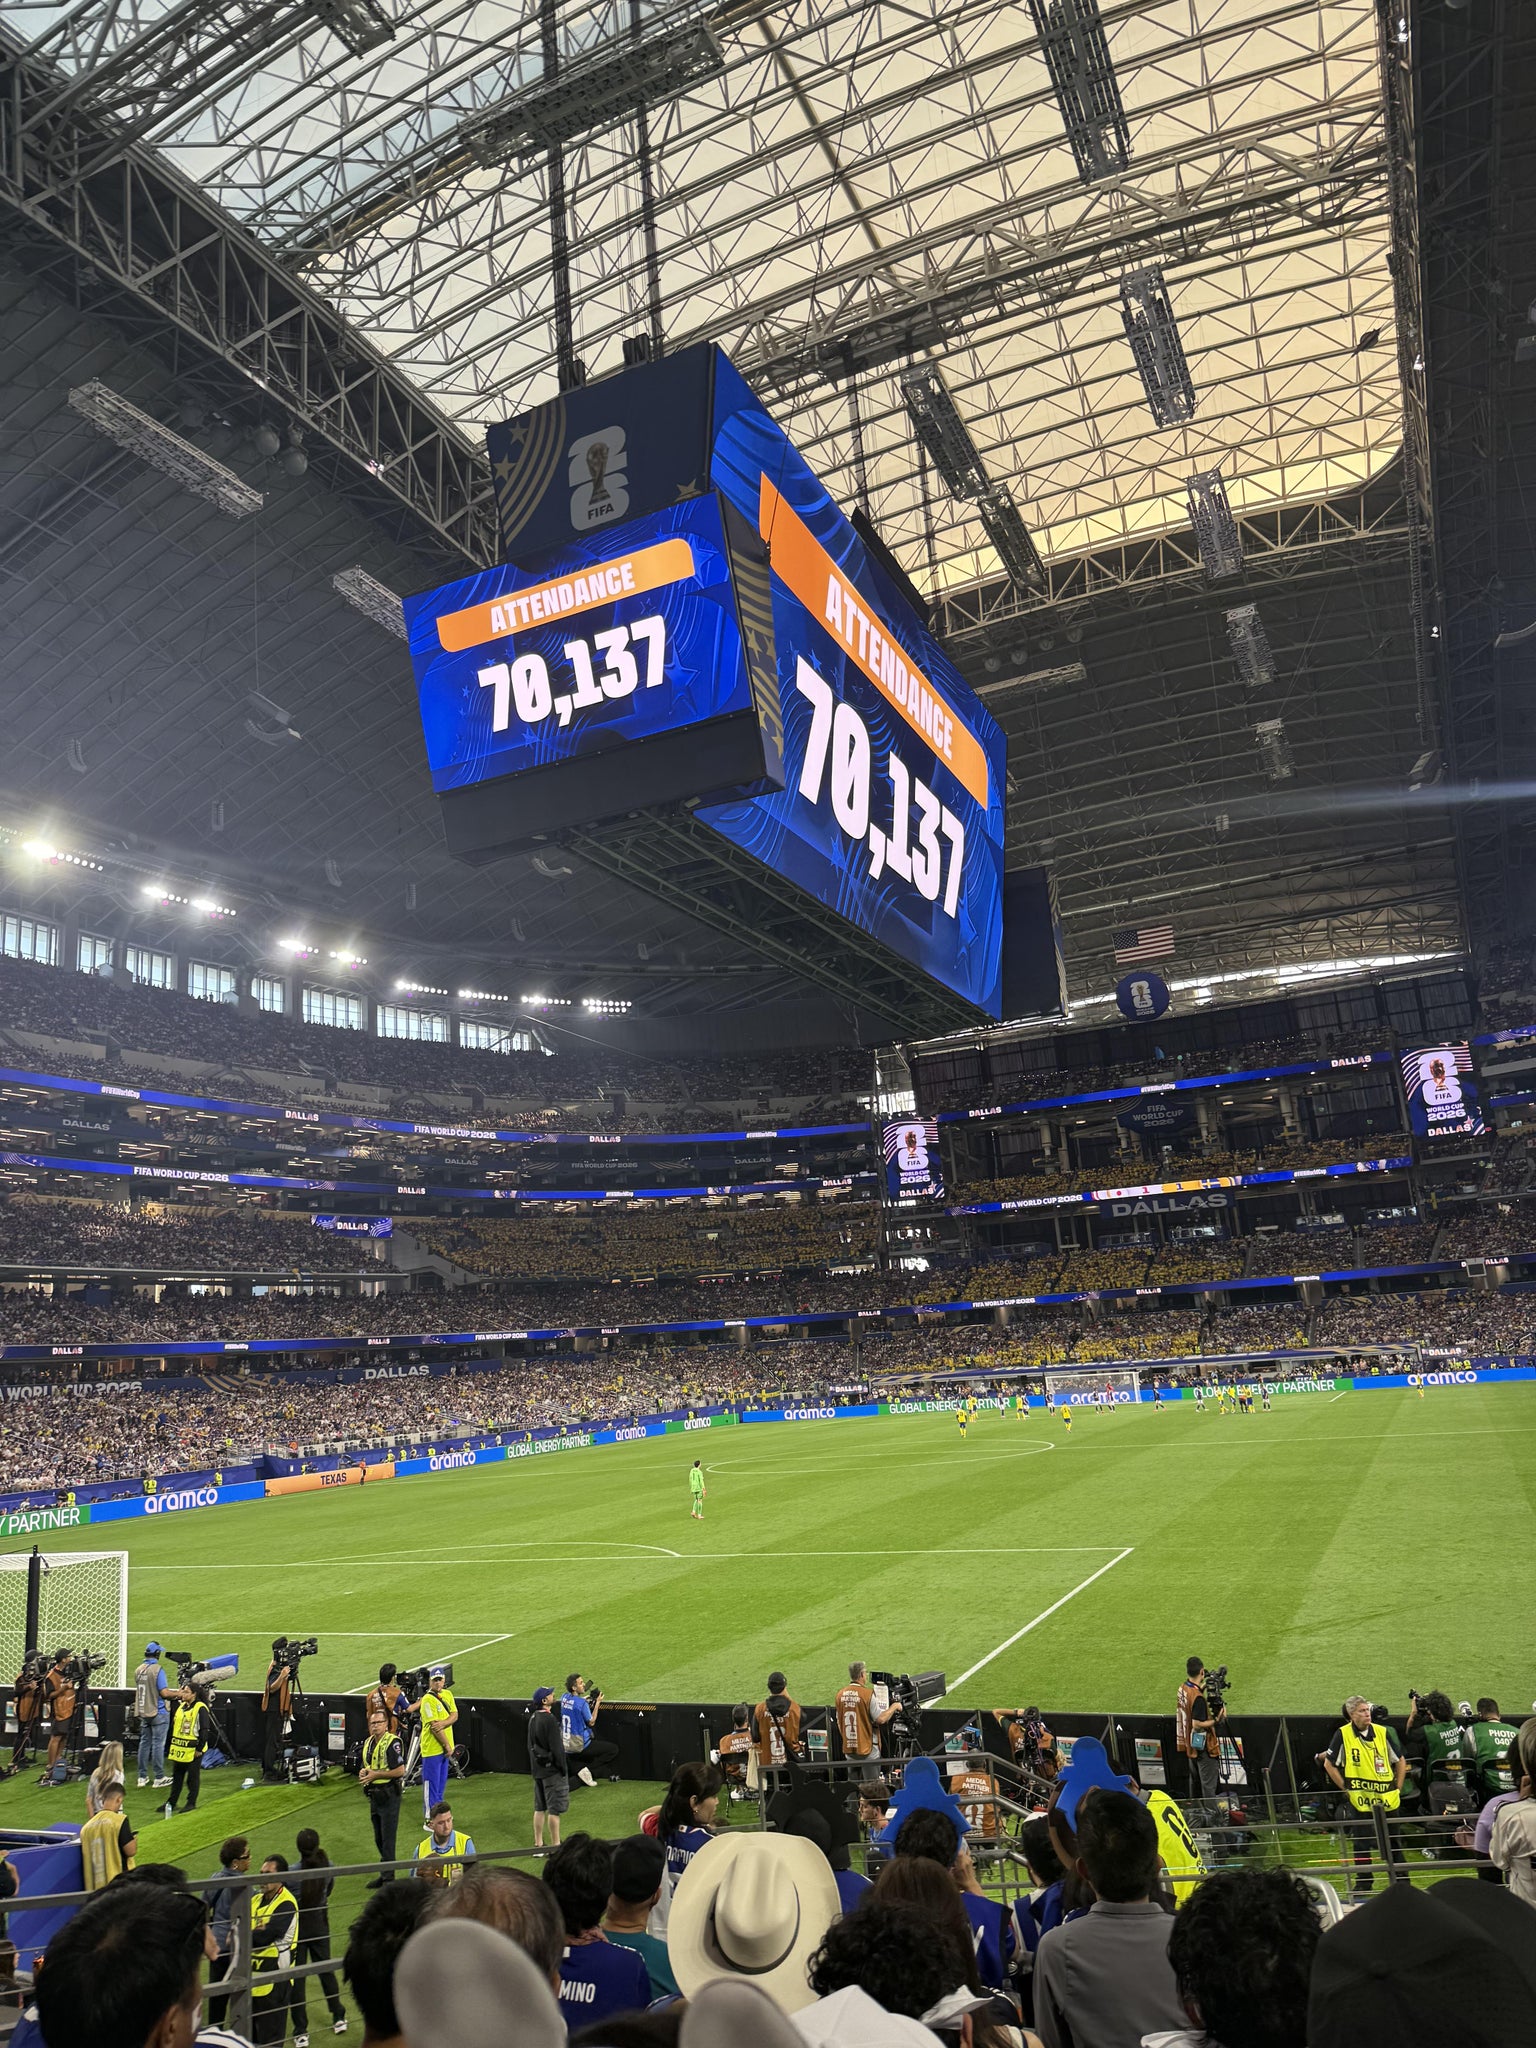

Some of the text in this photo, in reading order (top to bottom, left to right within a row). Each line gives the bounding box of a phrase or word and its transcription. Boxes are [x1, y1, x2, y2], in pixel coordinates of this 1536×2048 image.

[586, 502, 615, 521] FIFA
[490, 562, 636, 634] ATTENDANCE
[478, 614, 667, 733] 70,137
[825, 572, 953, 762] ATTENDANCE
[796, 654, 965, 920] 70,137
[1331, 1055, 1372, 1068] DALLAS
[969, 1106, 1002, 1117] DALLAS
[1147, 1104, 1167, 1112] FIFA
[1426, 1102, 1464, 1113] WORLD CUP
[285, 1110, 319, 1122] DALLAS
[1132, 1112, 1166, 1121] WORLD
[1427, 1109, 1467, 1122] 2026
[62, 1118, 110, 1131] DALLAS
[1144, 1118, 1175, 1128] 2026
[414, 1125, 496, 1139] FIFA WORLD CUP 2026
[1428, 1124, 1472, 1137] DALLAS
[444, 1158, 479, 1166] DALLAS
[134, 1166, 229, 1182] FIFA WORLD CUP 2026
[900, 1176, 931, 1184] 2026
[822, 1178, 852, 1186] DALLAS
[398, 1186, 426, 1195] DALLAS
[900, 1188, 934, 1198] DALLAS
[1017, 1199, 1042, 1207] WORLD
[1057, 1195, 1083, 1203] 2026
[1112, 1194, 1228, 1217] DALLAS
[337, 1222, 368, 1230] DALLAS
[52, 1347, 83, 1355] DALLAS
[1428, 1348, 1462, 1356] DALLAS
[365, 1365, 430, 1380] DALLAS
[1407, 1371, 1477, 1386] aramco
[95, 1381, 142, 1393] 2026
[1283, 1380, 1335, 1393] PARTNER
[784, 1406, 835, 1420] aramco
[889, 1401, 925, 1414] GLOBAL
[684, 1417, 711, 1430] aramco
[616, 1426, 646, 1441] aramco
[508, 1435, 590, 1458] GLOBAL ENERGY PARTNER
[430, 1452, 476, 1470] aramco
[320, 1473, 347, 1485] TEXAS
[145, 1489, 218, 1514] aramco
[8, 1508, 80, 1534] PARTNER
[1488, 1729, 1516, 1738] PHOTO
[731, 1737, 750, 1745] MEDIA
[962, 1783, 990, 1792] PARTNER
[965, 1777, 987, 1786] MEDIA
[1351, 1780, 1390, 1792] SECURITY
[558, 1980, 596, 2003] MINO
